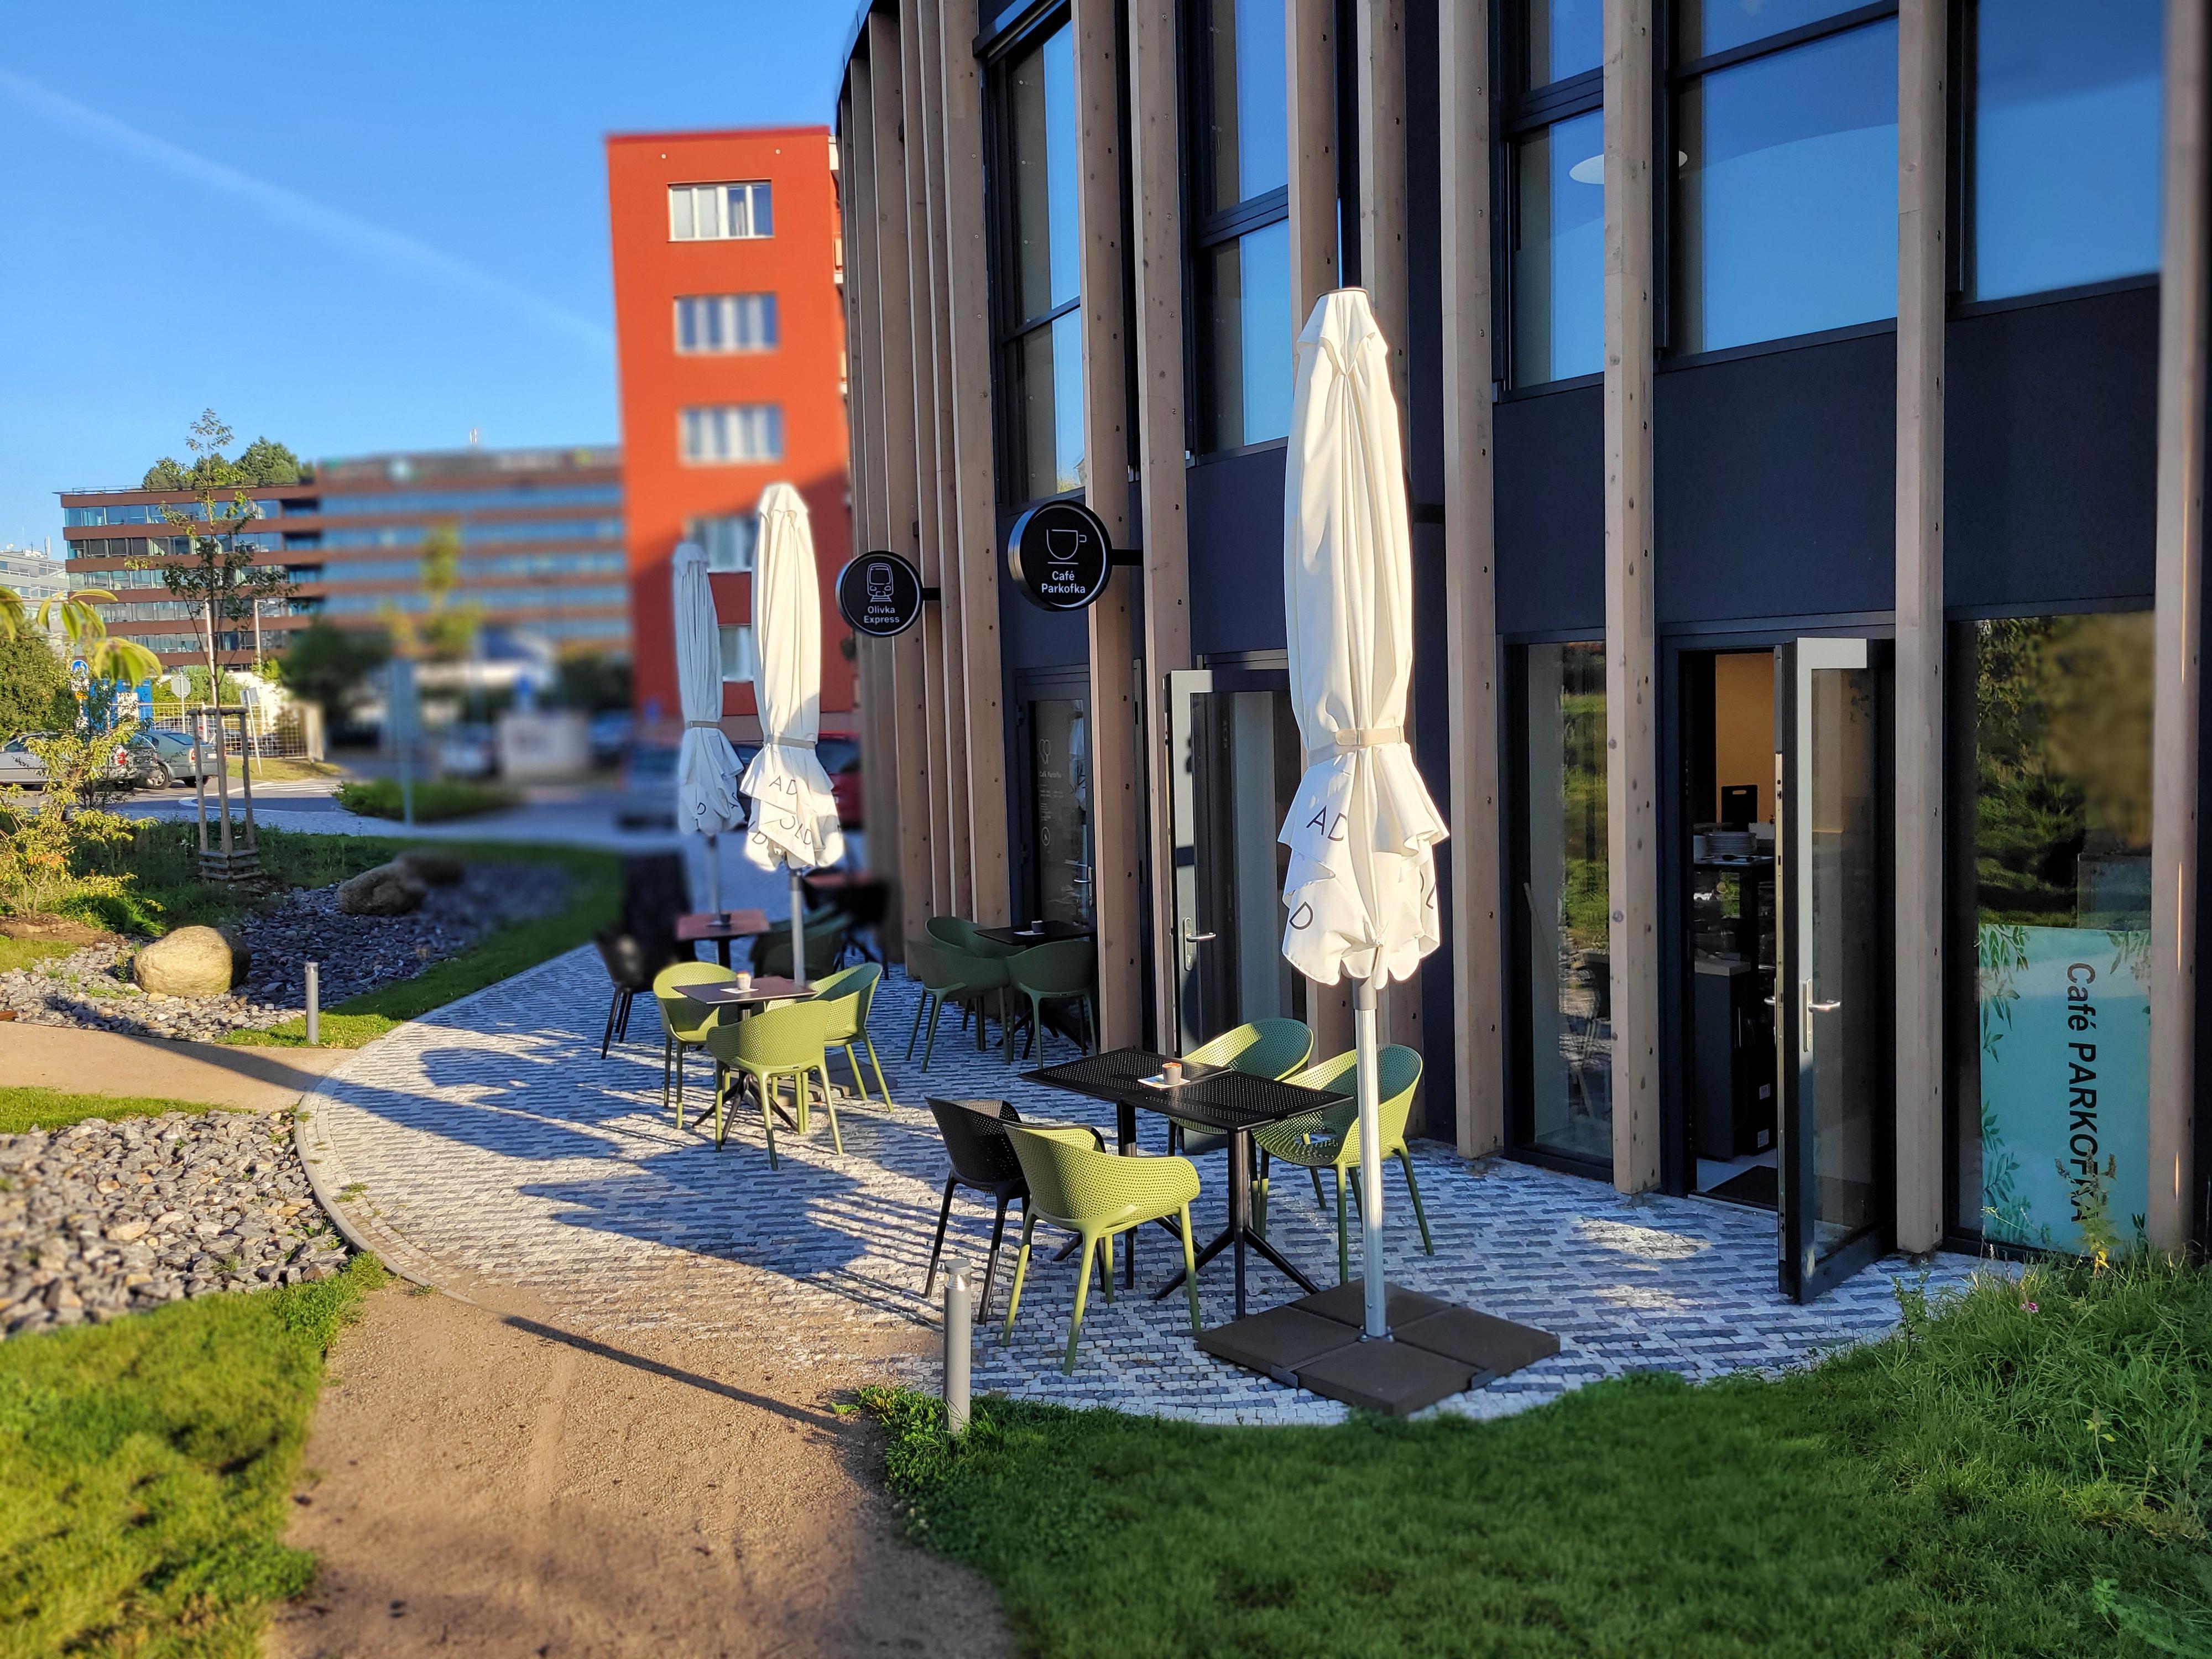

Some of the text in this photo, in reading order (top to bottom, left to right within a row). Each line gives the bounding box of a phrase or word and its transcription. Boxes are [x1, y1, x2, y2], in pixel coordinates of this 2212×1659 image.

[1052, 570, 1075, 581] Café
[1041, 582, 1086, 593] Parkofka
[867, 605, 895, 614] Olivka
[863, 615, 900, 625] Express
[2067, 963, 2096, 1031] Café
